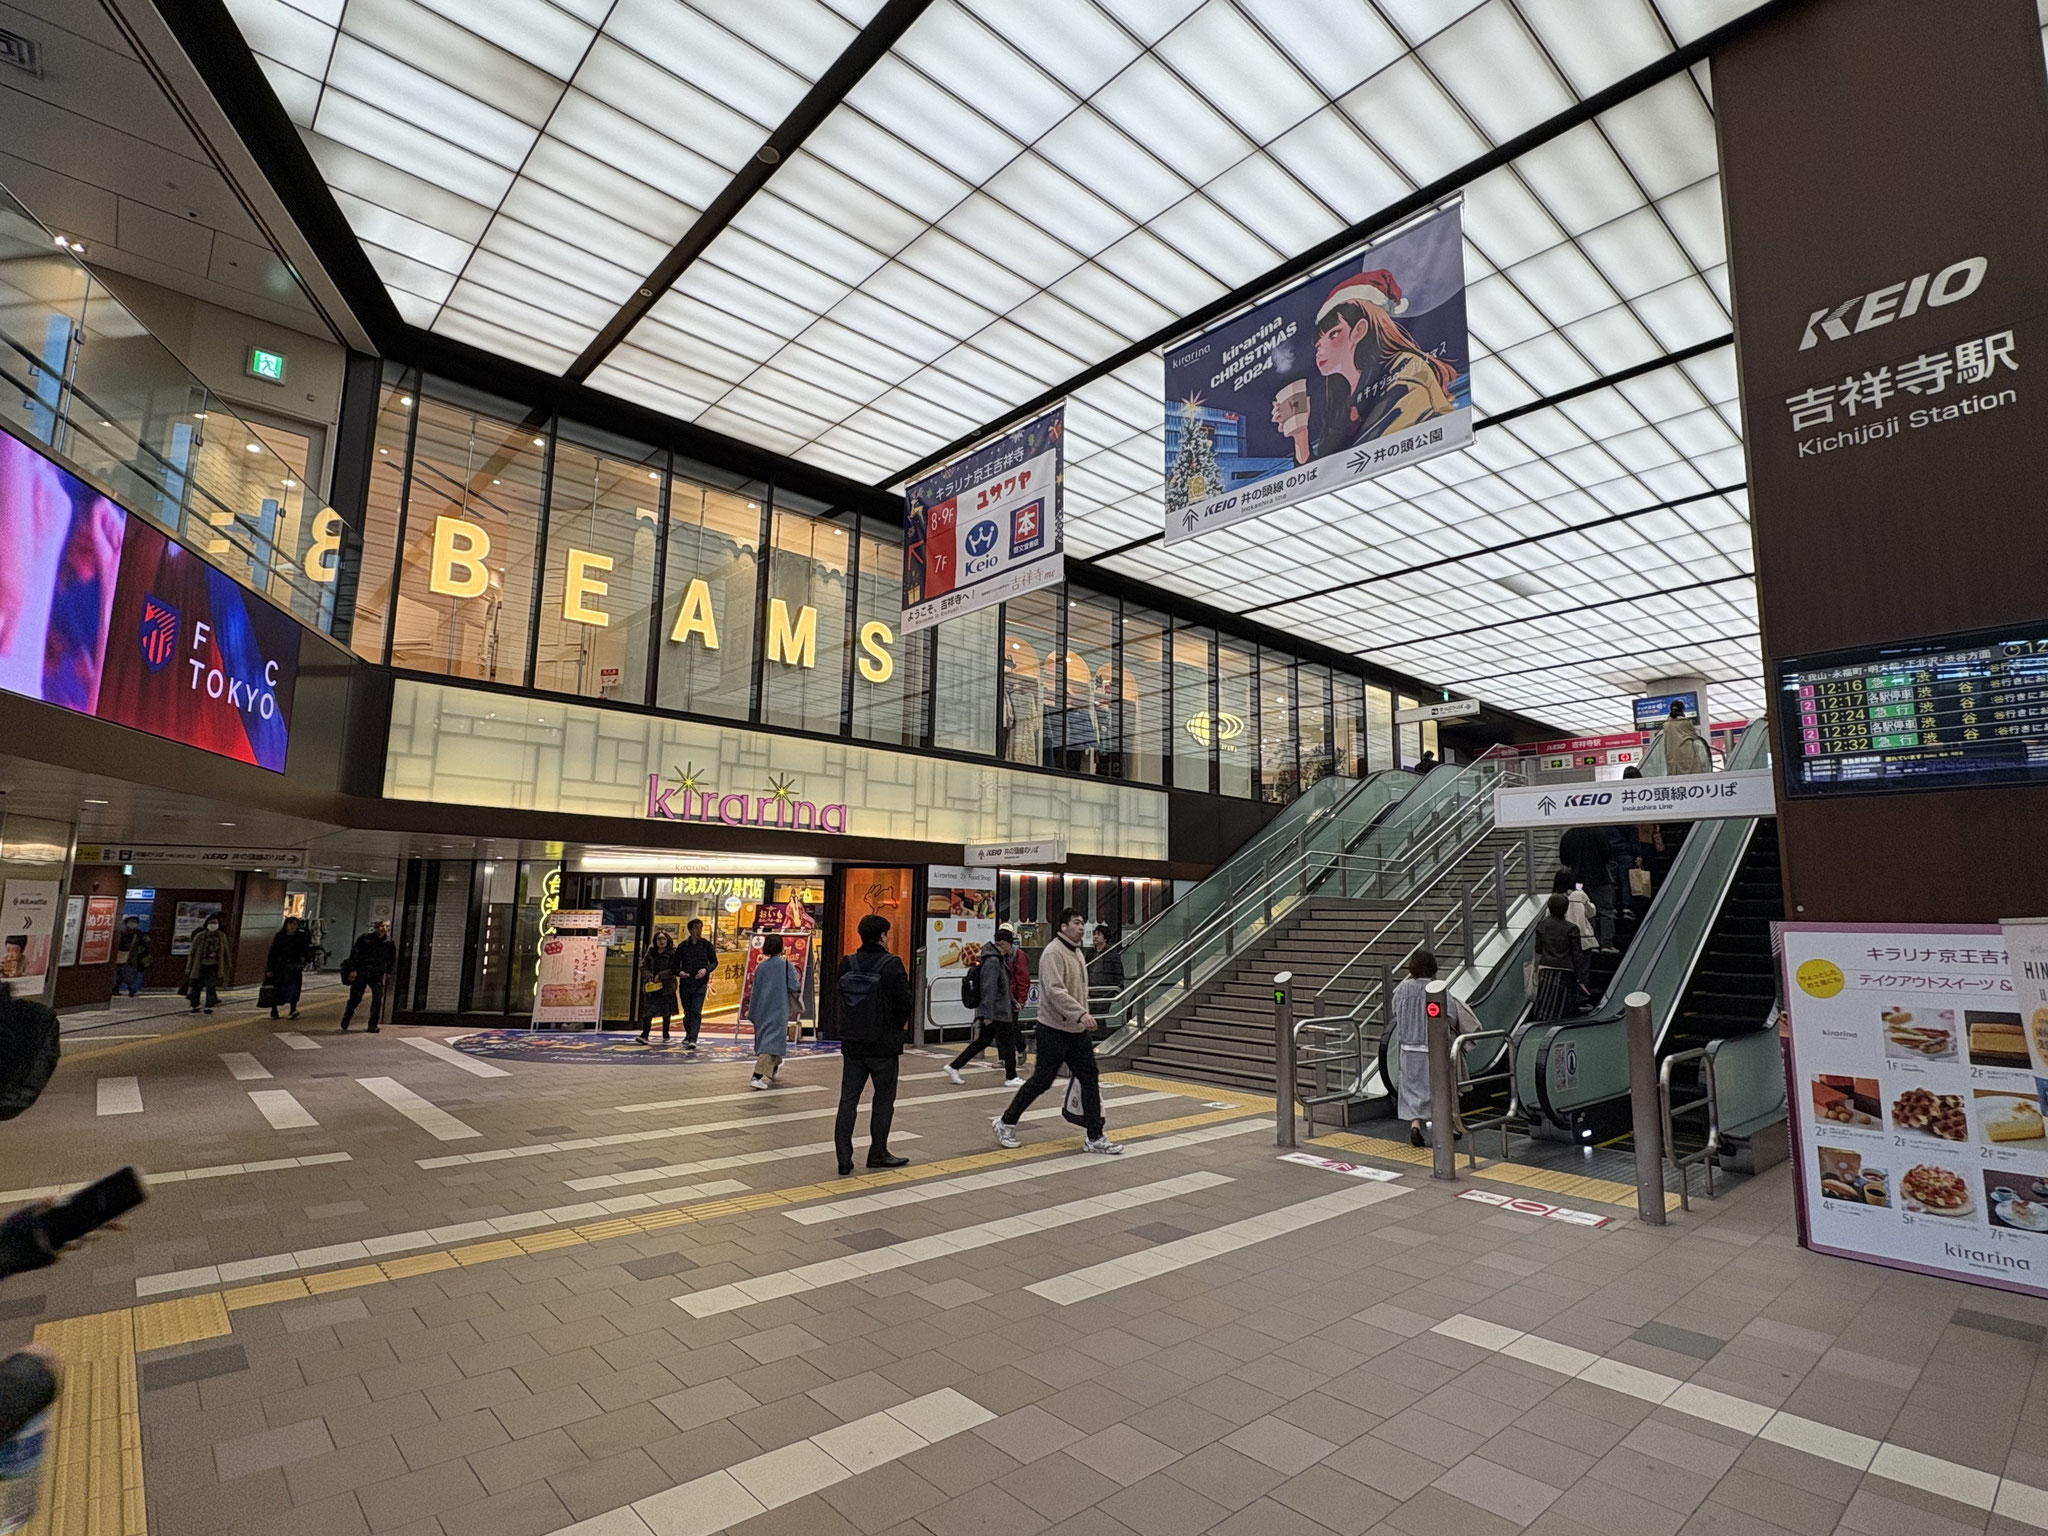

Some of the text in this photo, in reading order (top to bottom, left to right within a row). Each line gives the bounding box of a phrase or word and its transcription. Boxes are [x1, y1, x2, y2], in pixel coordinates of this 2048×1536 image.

[1798, 256, 1988, 351] KEIO
[1222, 316, 1282, 364] kirarina
[1172, 344, 1211, 368] kirarina
[1210, 321, 1297, 388] CHRISTMAS
[1234, 356, 1273, 391] 2024
[1785, 329, 2019, 432] 吉祥寺駅
[1798, 389, 2017, 458] Kichijōji Station
[1373, 428, 1443, 463] 井の頭公園
[936, 446, 1025, 500] キラリナ京王吉祥寺
[1241, 467, 1318, 505] 井の頭線 のりば
[1204, 497, 1237, 517] KEIO
[1018, 511, 1036, 536] 本
[934, 555, 948, 574] 7F
[965, 553, 998, 576] Keio
[1011, 568, 1043, 591] 吉祥寺
[430, 515, 894, 683] BEAMS
[193, 621, 210, 650] F
[189, 658, 275, 720] TOKYO
[1818, 679, 1862, 695] 12:16
[1820, 693, 1864, 710] 12:17
[1868, 688, 1914, 704] 各駅停車
[1822, 709, 1866, 724] 12:24
[1875, 705, 1909, 718] 急行
[1823, 723, 1867, 739] 12:25
[1871, 718, 1916, 734] 各駅停車
[1825, 738, 1869, 753] 12:32
[1878, 735, 1913, 748] 急行
[646, 765, 848, 834] kirarina
[1564, 781, 1738, 808] KEIO 井の頭線のりば
[1622, 803, 1657, 812] Inokashira
[202, 853, 229, 861] KEIO
[1859, 973, 2014, 992] テイクアウトスイーツ &
[1822, 1029, 1858, 1039] kirarina
[1886, 1060, 1898, 1071] 1F
[1970, 1066, 1983, 1079] 2F
[1815, 1125, 1827, 1137] 2F
[1893, 1136, 1907, 1147] 2F
[1980, 1147, 1994, 1159] 2F
[1823, 1200, 1835, 1212] 4F
[1902, 1213, 1916, 1225] 5F
[1989, 1228, 2004, 1240] 7F
[1944, 1242, 2031, 1271] kirarina
